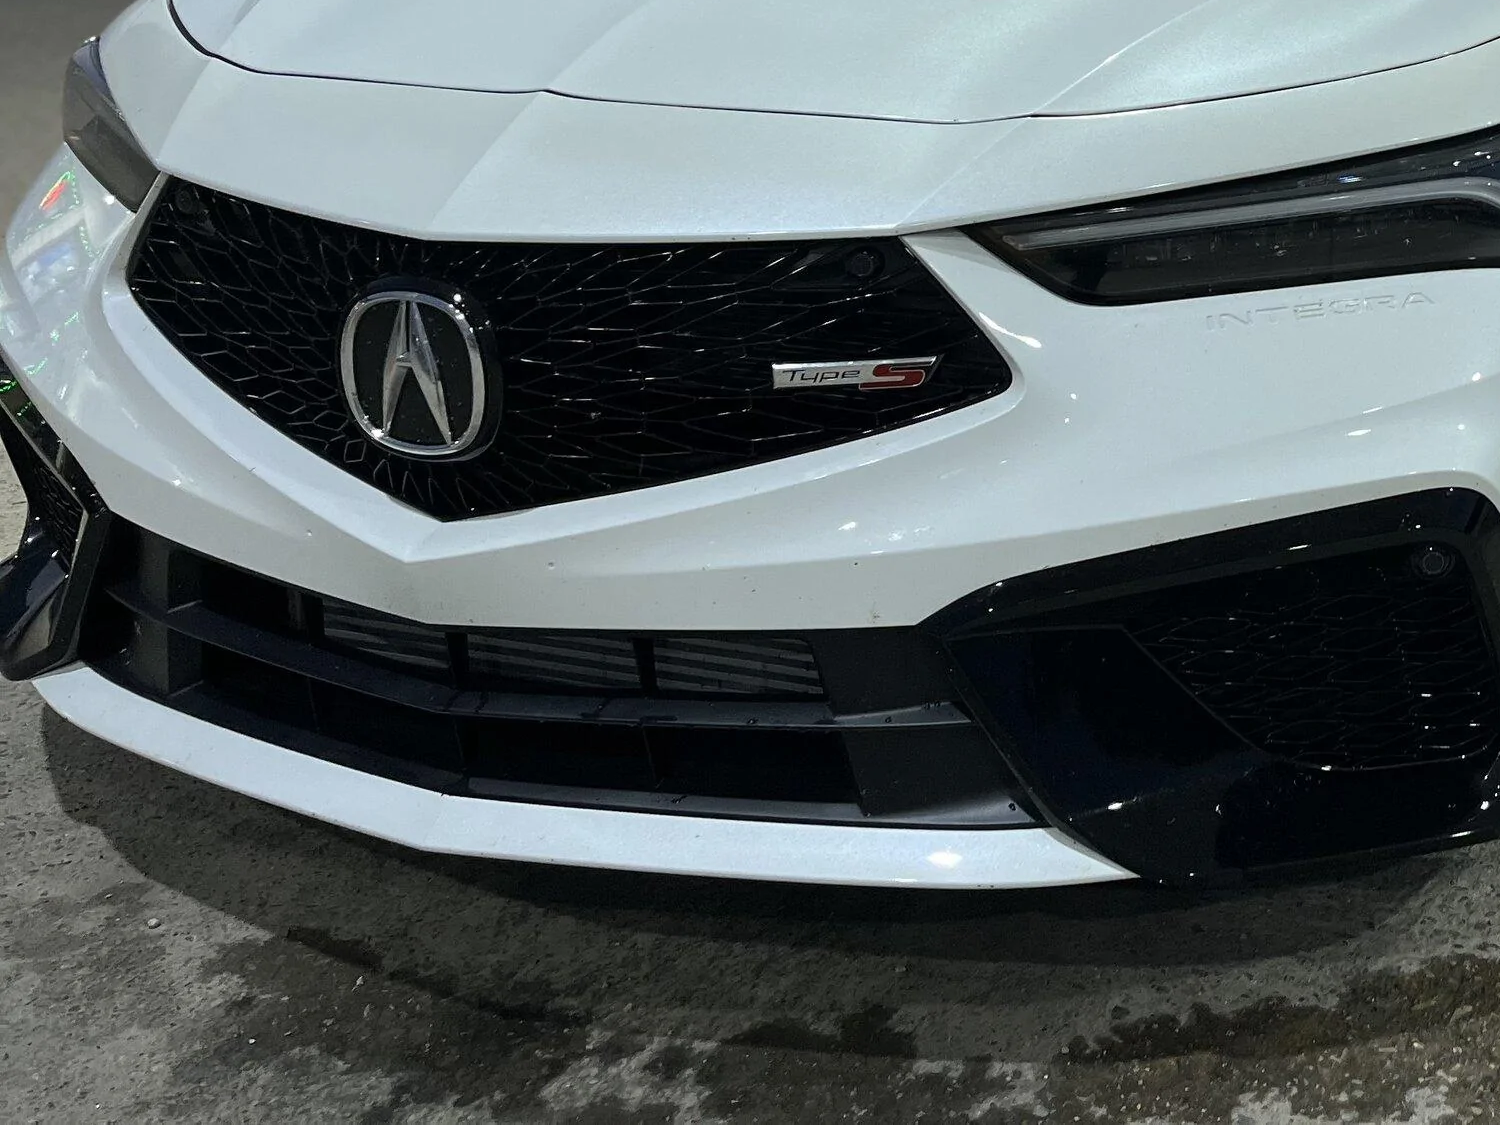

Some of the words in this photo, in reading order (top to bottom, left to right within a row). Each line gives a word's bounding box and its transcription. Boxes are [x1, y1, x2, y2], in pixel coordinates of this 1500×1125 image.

[1205, 291, 1436, 331] INTEGRA
[782, 368, 861, 385] Type
[857, 362, 927, 393] S
